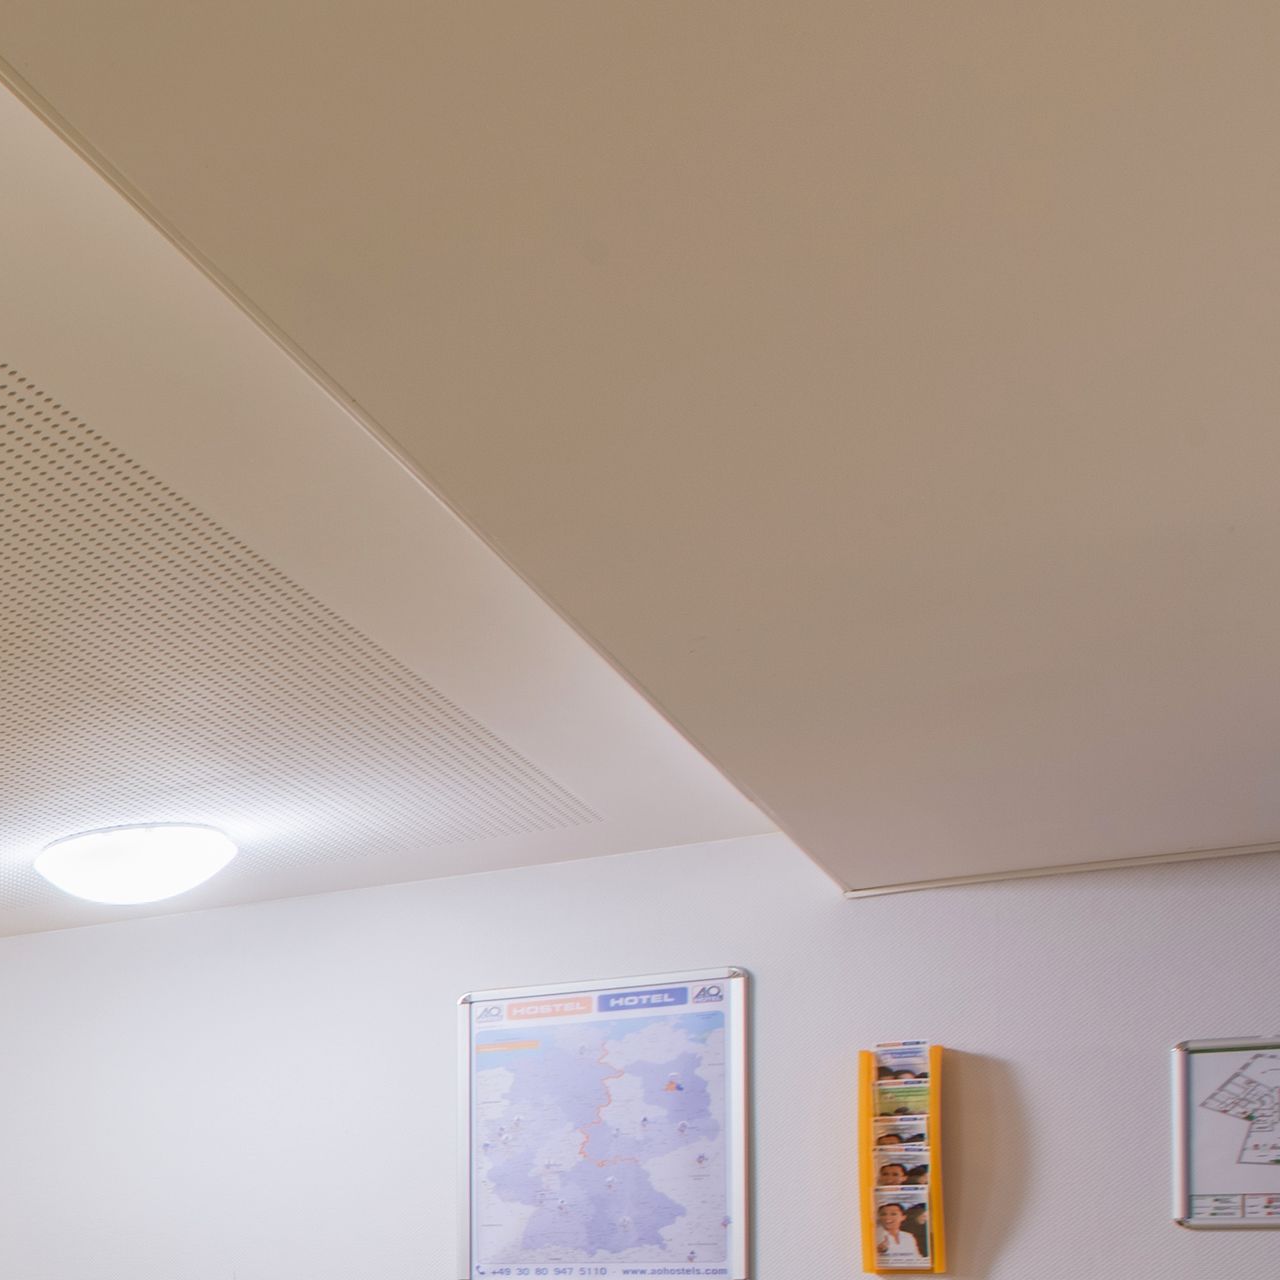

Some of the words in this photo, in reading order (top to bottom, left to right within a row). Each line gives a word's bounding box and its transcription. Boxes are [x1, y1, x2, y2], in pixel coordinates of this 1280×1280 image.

[512, 1002, 585, 1016] HOSTEL
[609, 993, 675, 1007] HOTEL
[579, 1266, 608, 1276] 5110
